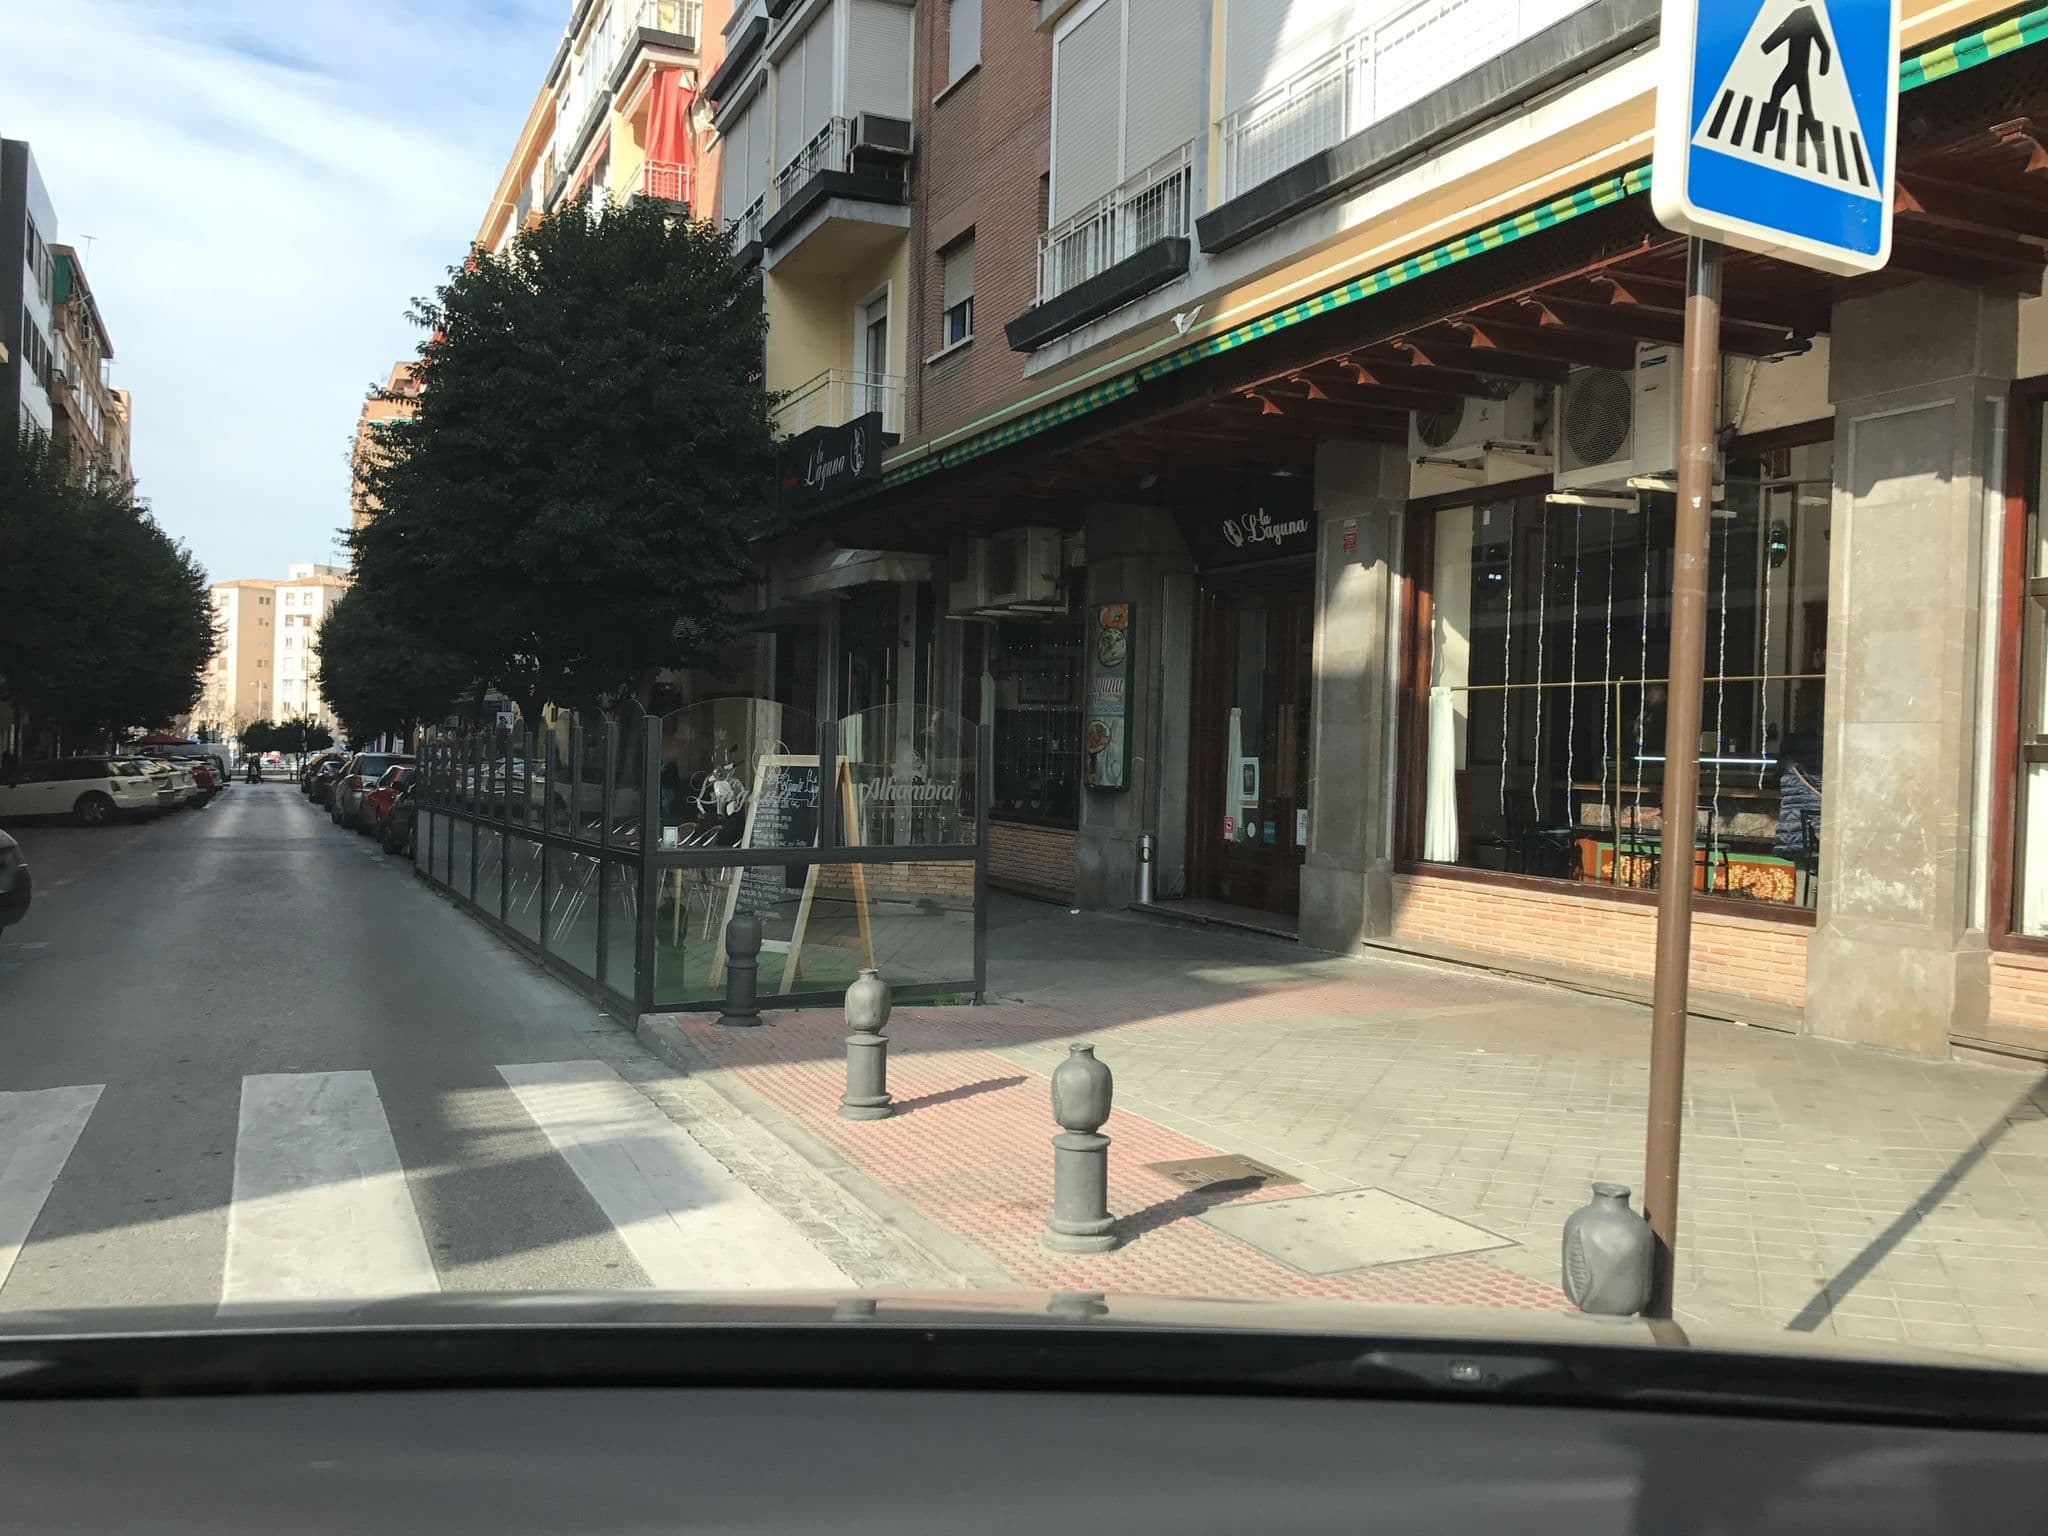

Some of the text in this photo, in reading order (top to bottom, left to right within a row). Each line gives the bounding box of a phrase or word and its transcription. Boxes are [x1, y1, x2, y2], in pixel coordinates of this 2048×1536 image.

[804, 452, 846, 491] Laguna
[1241, 513, 1309, 545] Laguna
[858, 777, 954, 801] Alhambra
